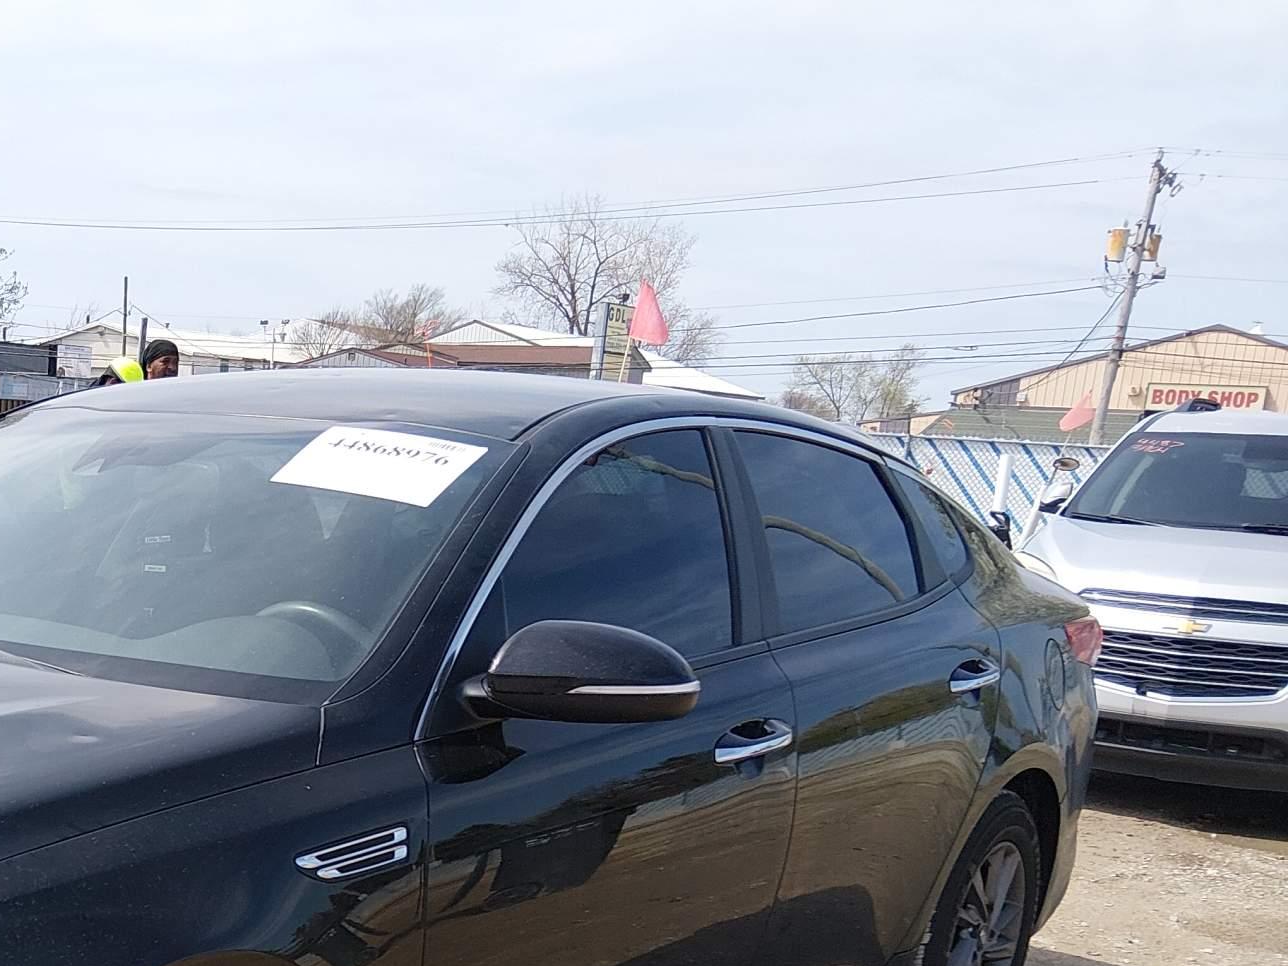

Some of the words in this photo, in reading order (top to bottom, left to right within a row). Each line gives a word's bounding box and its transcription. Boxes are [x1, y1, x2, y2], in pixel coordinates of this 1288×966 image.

[1151, 389, 1202, 405] BODY
[1207, 390, 1259, 408] SHOP
[328, 438, 450, 466] 44868976
